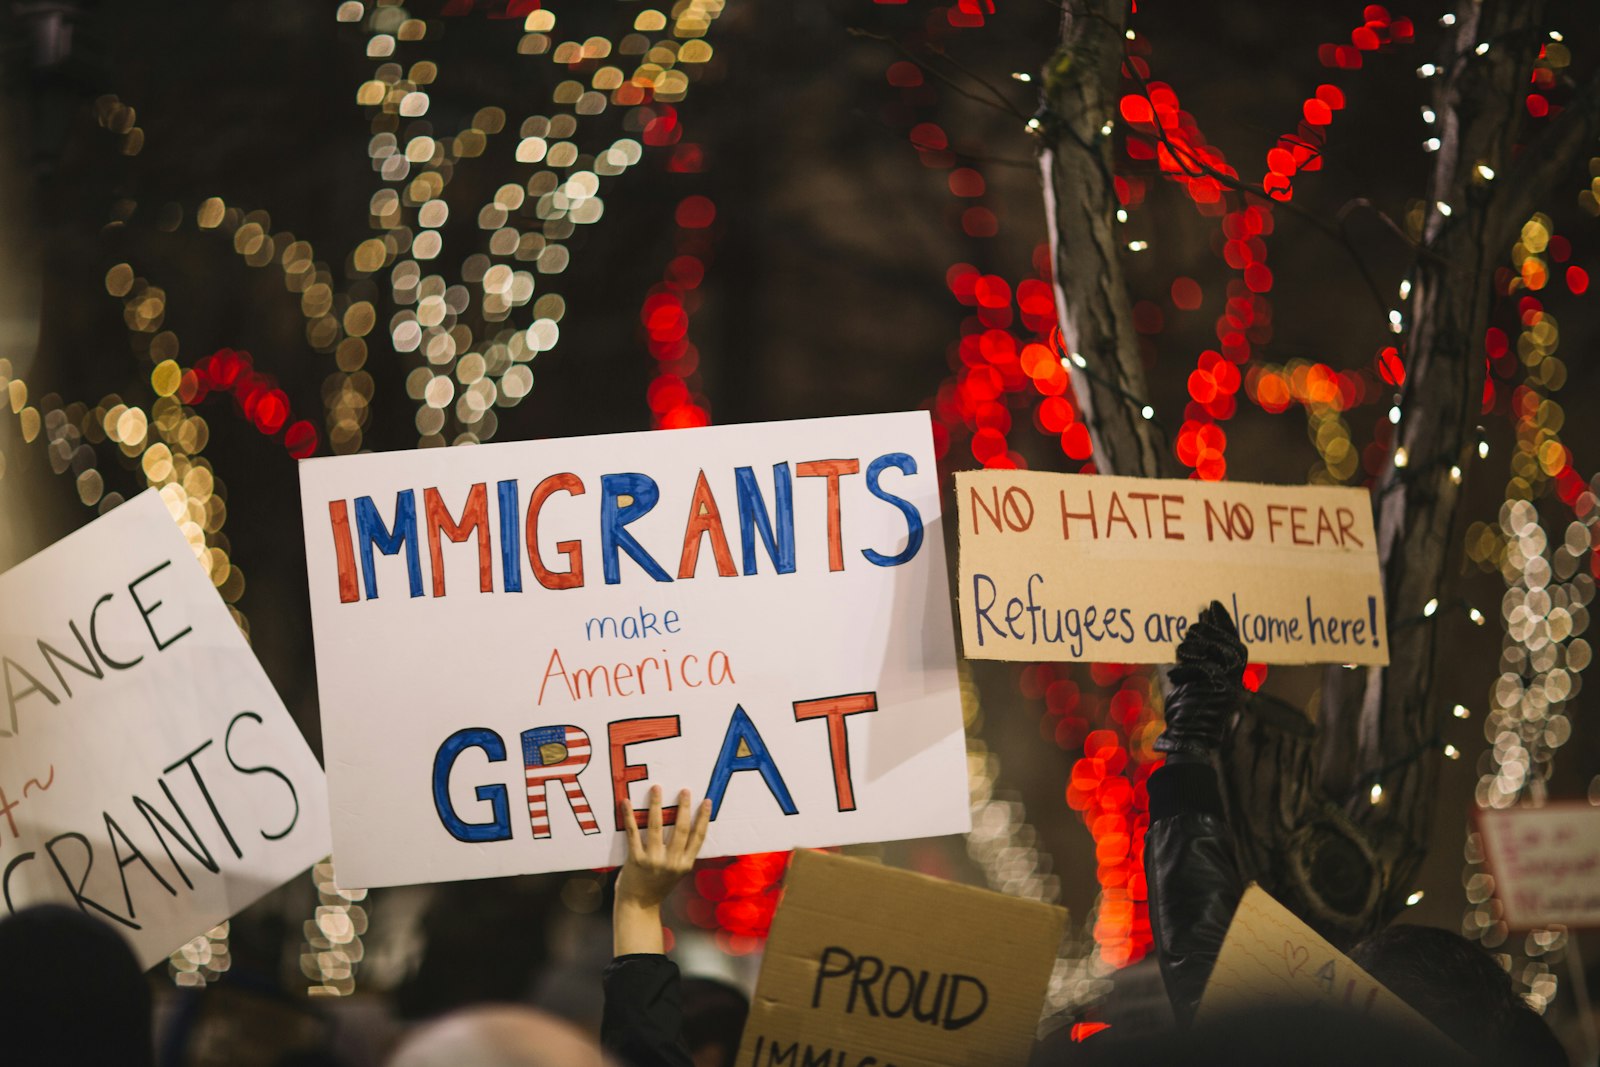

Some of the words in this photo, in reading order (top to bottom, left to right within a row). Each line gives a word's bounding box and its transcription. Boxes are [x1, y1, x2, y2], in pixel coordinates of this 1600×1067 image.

[328, 452, 924, 604] IMMIGRANTS
[970, 486, 1034, 535] NO
[1060, 489, 1185, 540] HATE
[1204, 499, 1255, 542] NO
[1267, 503, 1365, 548] FEAR
[0, 559, 193, 738] ANCE
[585, 604, 681, 642] make
[973, 573, 1135, 658] Refugees
[1144, 613, 1188, 643] are
[1199, 592, 1303, 645] lcome
[1306, 595, 1379, 649] here!
[537, 646, 736, 706] America
[432, 691, 878, 844] GREAT
[812, 946, 988, 1030] PROUD
